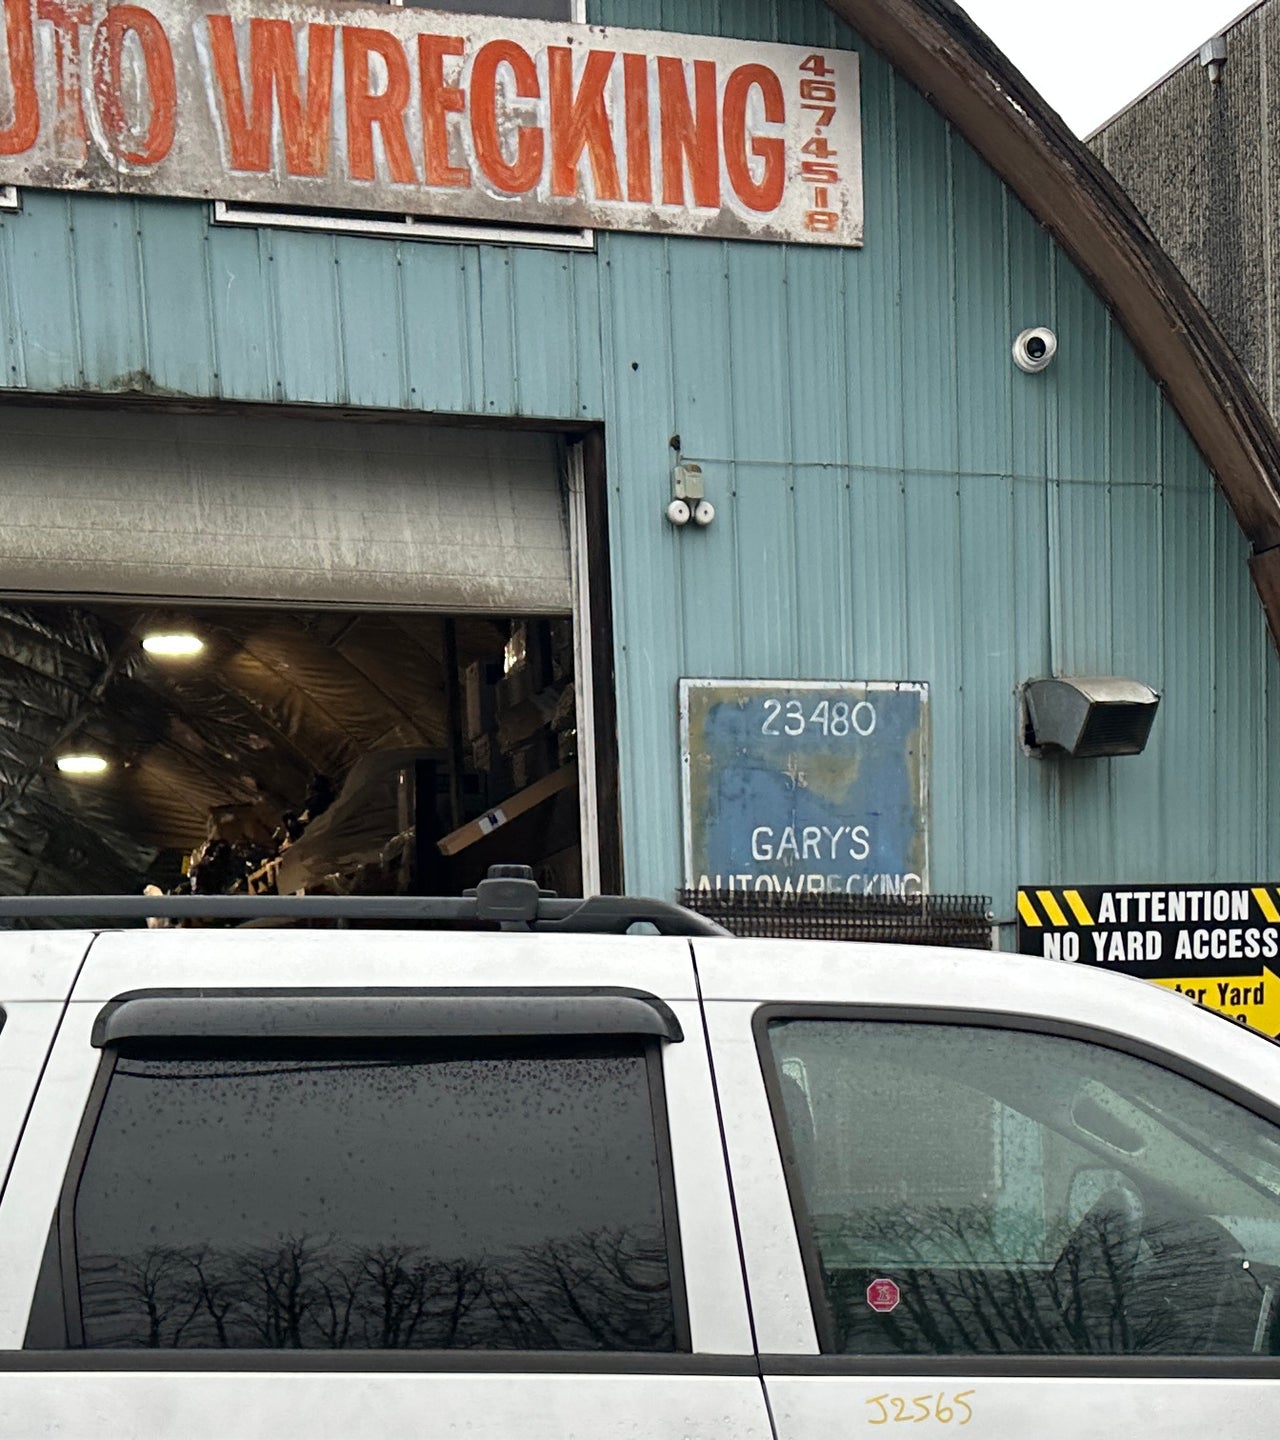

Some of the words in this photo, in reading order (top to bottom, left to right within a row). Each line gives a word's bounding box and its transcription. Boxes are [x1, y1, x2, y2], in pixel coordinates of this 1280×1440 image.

[204, 12, 786, 212] WRECKING
[761, 700, 876, 736] 23480
[751, 825, 870, 860] GARY'S
[1098, 890, 1249, 924] ATTENTION
[1043, 931, 1079, 962] NO
[1092, 929, 1163, 962] YARD
[1217, 982, 1264, 1006] Yard
[865, 1389, 976, 1425] J2565
